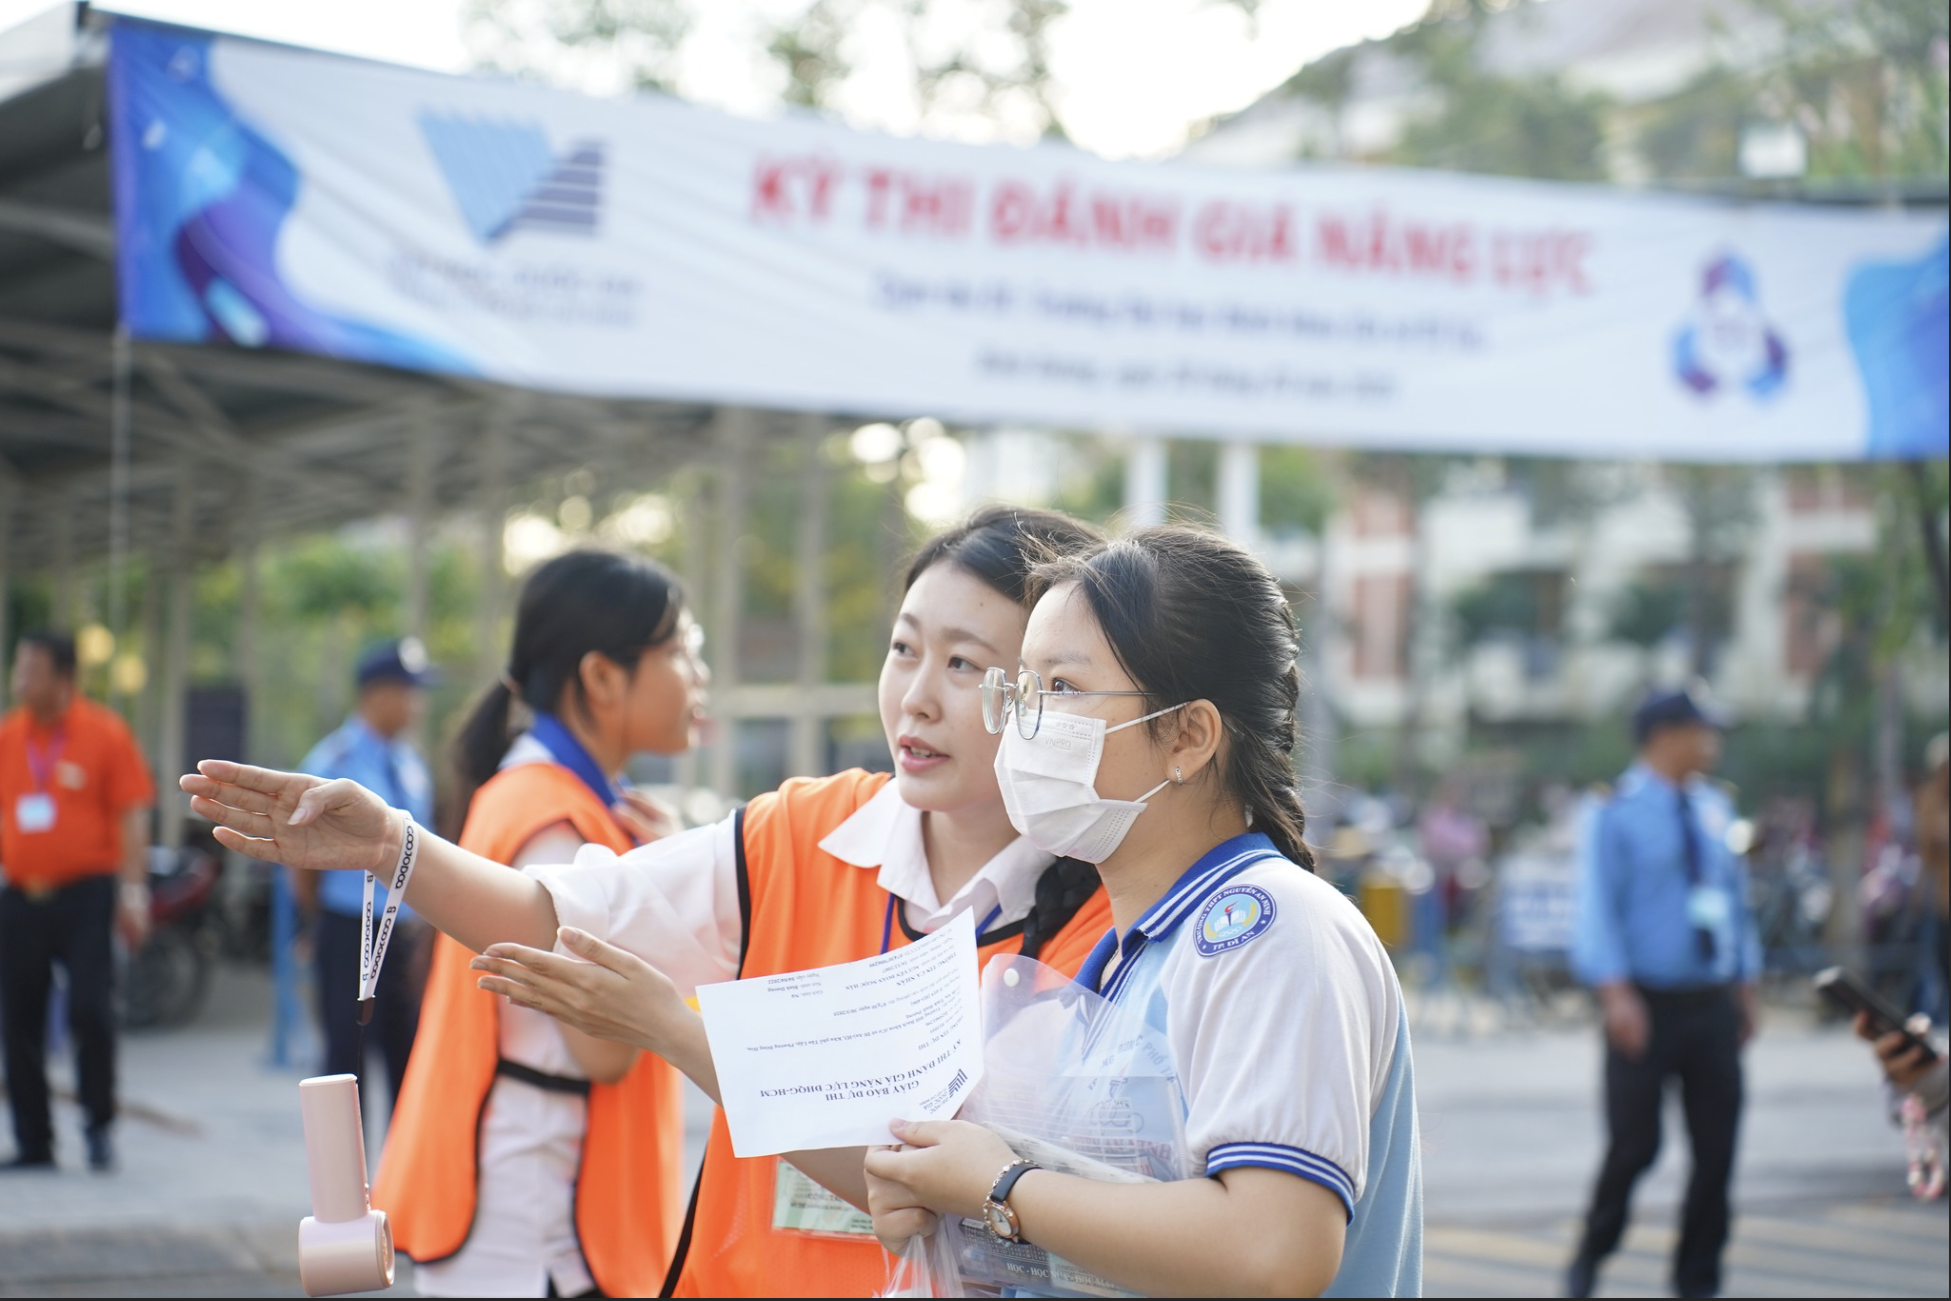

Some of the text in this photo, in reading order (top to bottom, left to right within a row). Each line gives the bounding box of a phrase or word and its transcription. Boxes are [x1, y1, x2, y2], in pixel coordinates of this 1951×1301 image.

[866, 164, 973, 241] THI
[992, 168, 1178, 257] ĐÁNH
[1193, 190, 1296, 265] GIÁ
[1316, 197, 1475, 286] NĂNG
[1204, 893, 1223, 913] THPT
[1255, 891, 1266, 900] AN
[1240, 930, 1255, 942] AN
[937, 1050, 951, 1064] THI
[907, 1060, 936, 1078] ĐÁNH
[825, 1081, 848, 1091] LỰC
[851, 1078, 882, 1089] NĂNG
[885, 1073, 905, 1086] GIÁ
[760, 1084, 822, 1097] ĐHQG-HCM
[825, 1080, 919, 1101] GIẤY BÁO DỰ THI
[1007, 1263, 1026, 1275] HỌC
[1030, 1267, 1050, 1279] HỌC
